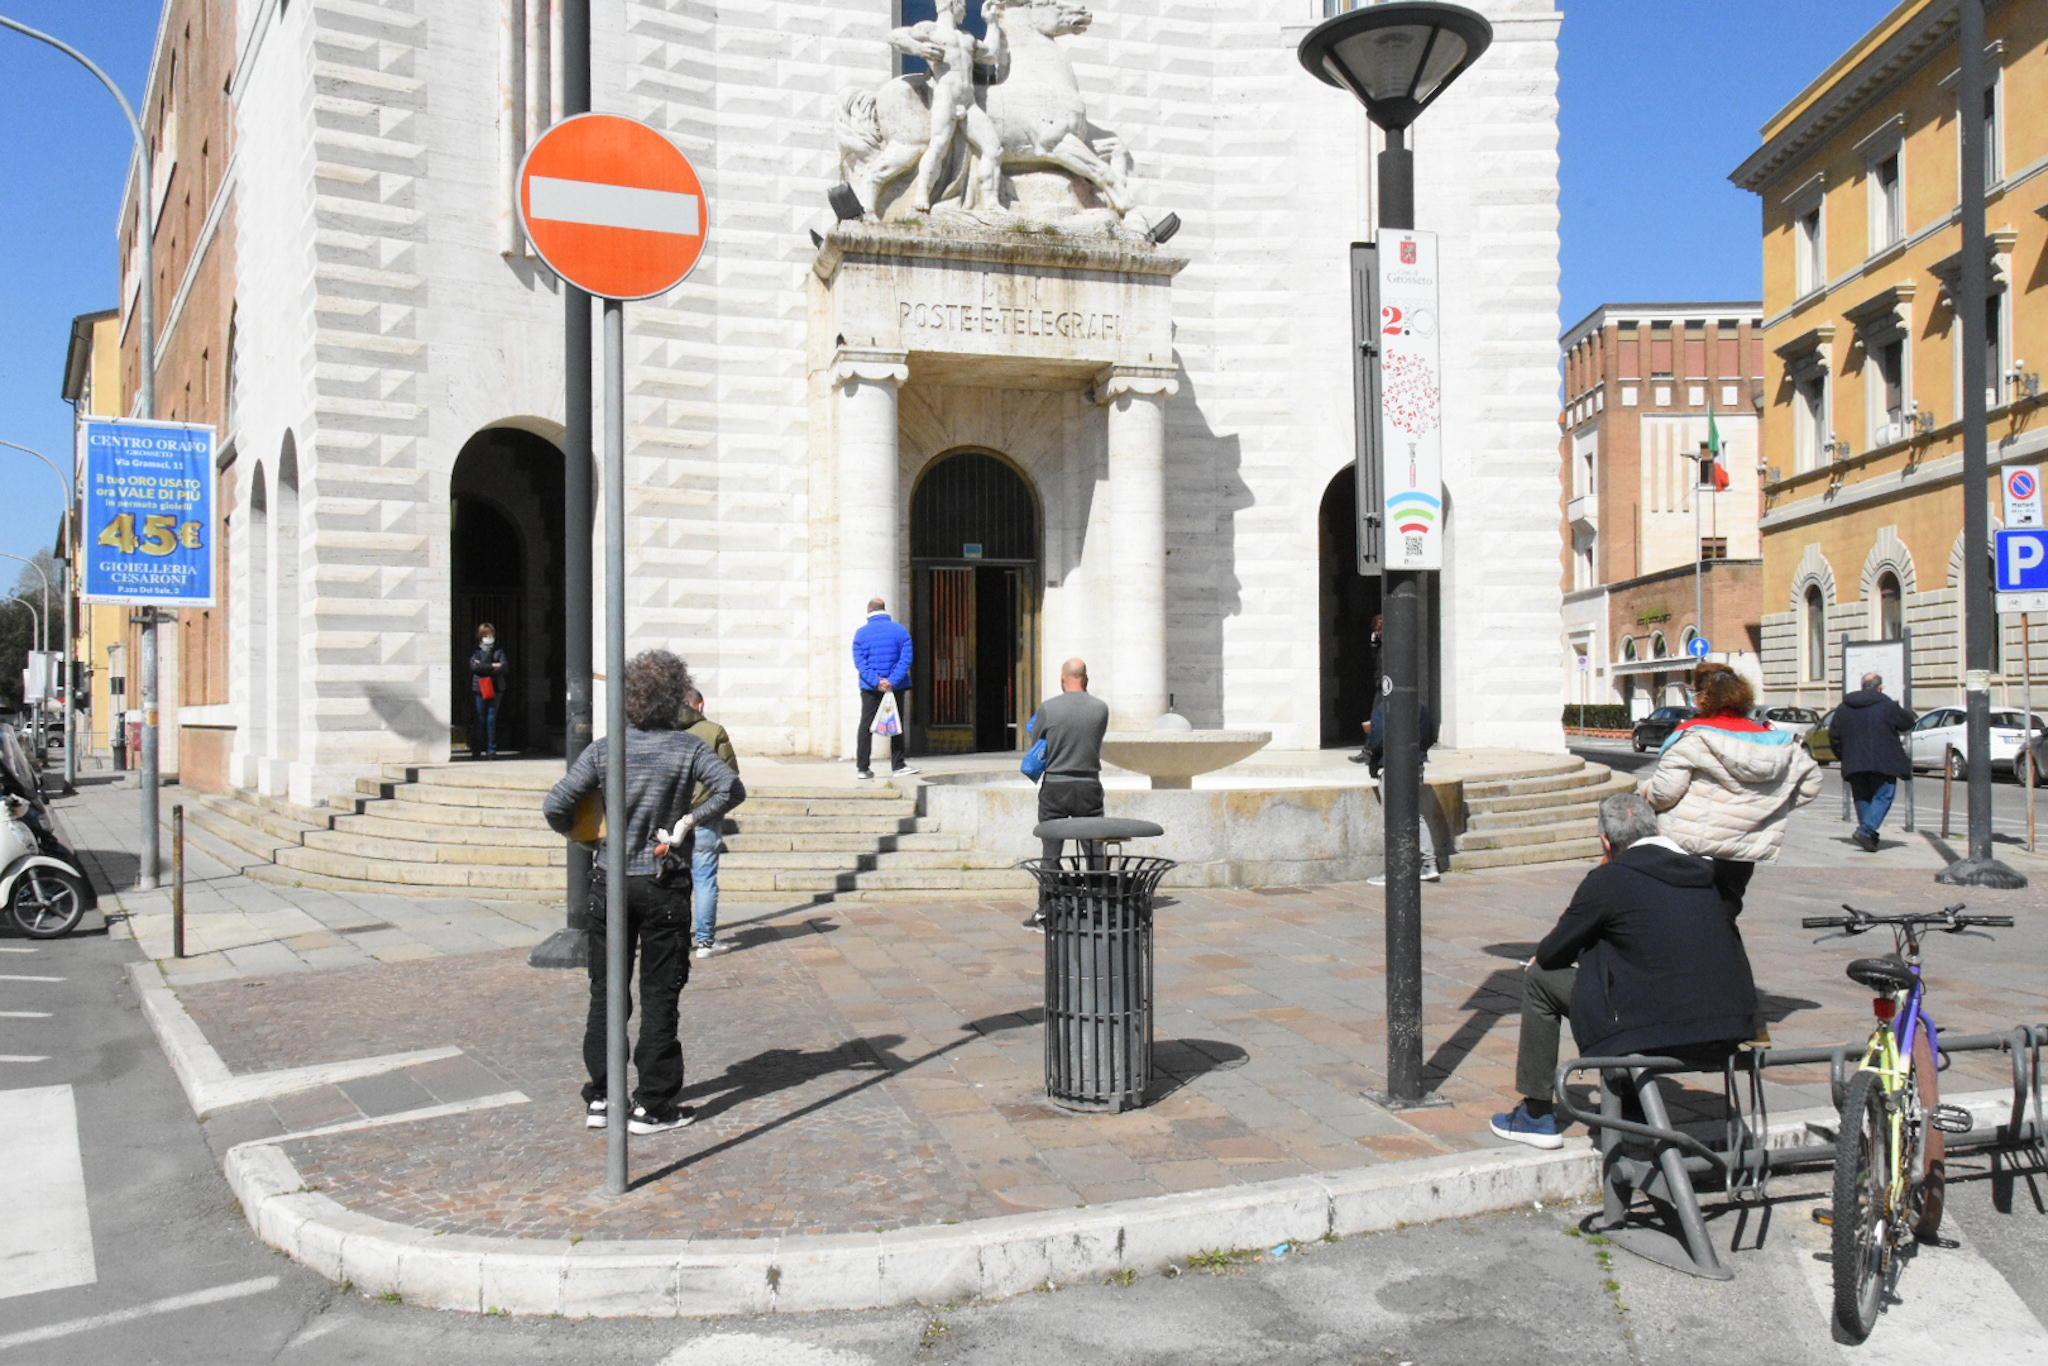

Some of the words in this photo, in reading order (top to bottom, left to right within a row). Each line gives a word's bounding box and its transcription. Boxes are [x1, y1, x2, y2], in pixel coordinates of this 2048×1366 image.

[90, 435, 153, 449] CENTRO
[156, 439, 207, 453] ORAFO
[115, 458, 130, 466] Via
[173, 462, 183, 470] 11
[107, 475, 125, 485] tuo
[128, 476, 157, 486] ORO
[160, 478, 201, 489] USATO
[96, 488, 116, 497] ora
[119, 487, 155, 499] VALE
[159, 489, 173, 500] DI
[177, 488, 201, 501] PIÙ
[2008, 536, 2045, 586] P
[99, 561, 198, 576] GIOIELLERIA
[111, 573, 187, 584] CESARONI
